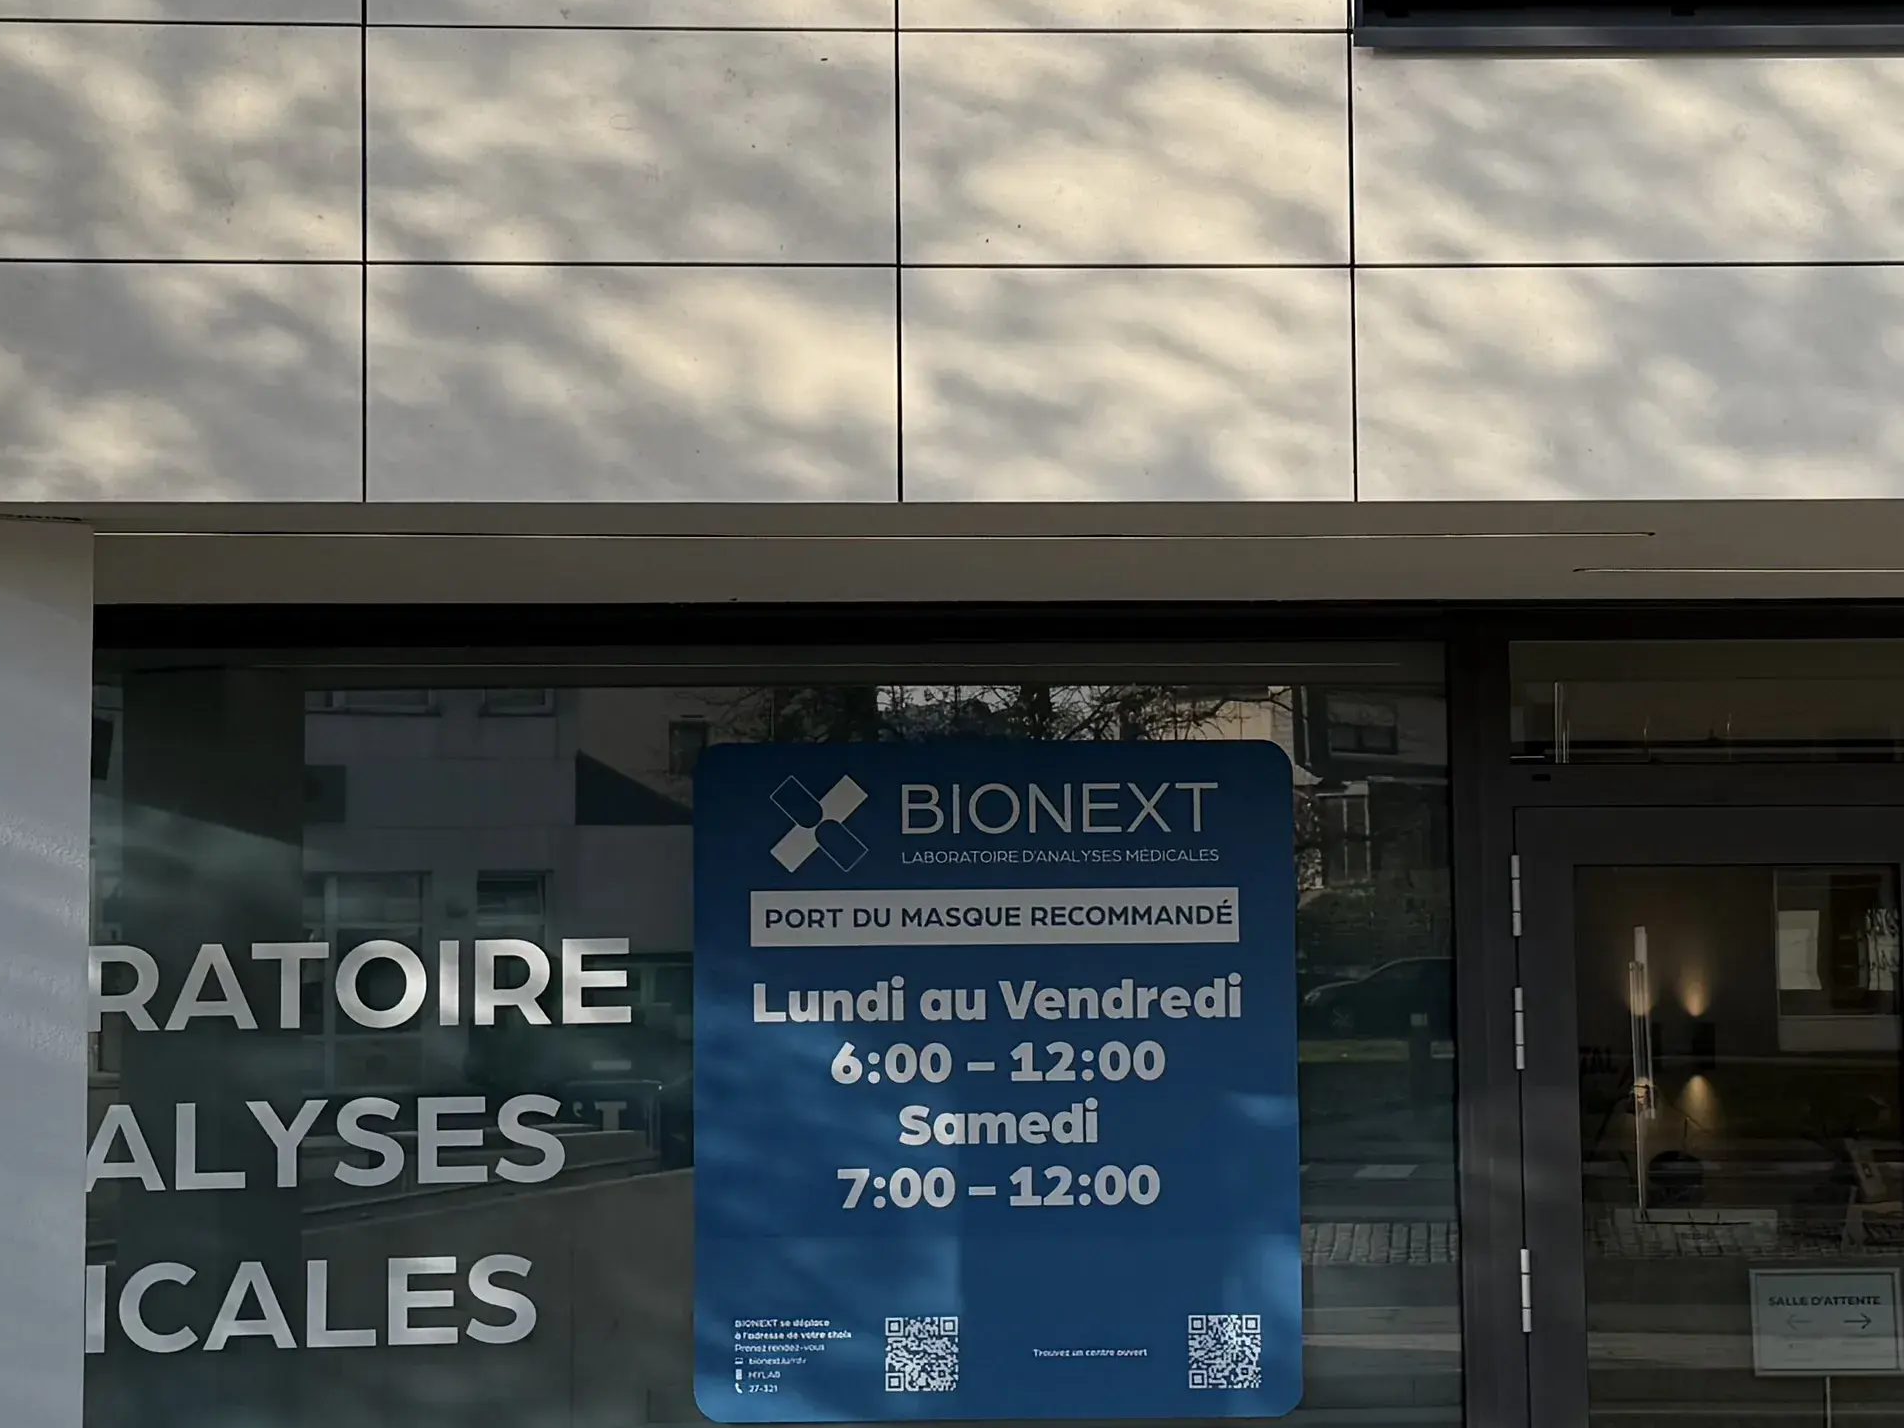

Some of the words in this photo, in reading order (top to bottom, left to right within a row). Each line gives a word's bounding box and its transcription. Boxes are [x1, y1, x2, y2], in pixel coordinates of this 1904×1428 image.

[902, 781, 1219, 835] BIONEXT
[901, 849, 1020, 865] LABORATOIRE
[1022, 848, 1123, 864] D'ANALYSES
[1125, 845, 1221, 863] MÉDICALES
[765, 907, 844, 929] PORT
[852, 907, 892, 929] DU
[900, 905, 1022, 928] MASQUE
[1030, 899, 1234, 927] RECOMMANDÉ
[752, 974, 905, 1023] Lundi
[919, 988, 987, 1021] au
[998, 972, 1243, 1020] Vendredi
[830, 1040, 953, 1086] 6:00
[1009, 1039, 1167, 1083] 12:00
[898, 1097, 1100, 1147] Samedi
[836, 1166, 957, 1210] 7:00
[1008, 1164, 1162, 1208] 12:00
[1768, 1295, 1809, 1307] SALLE
[1810, 1294, 1882, 1307] D'ATTENTE
